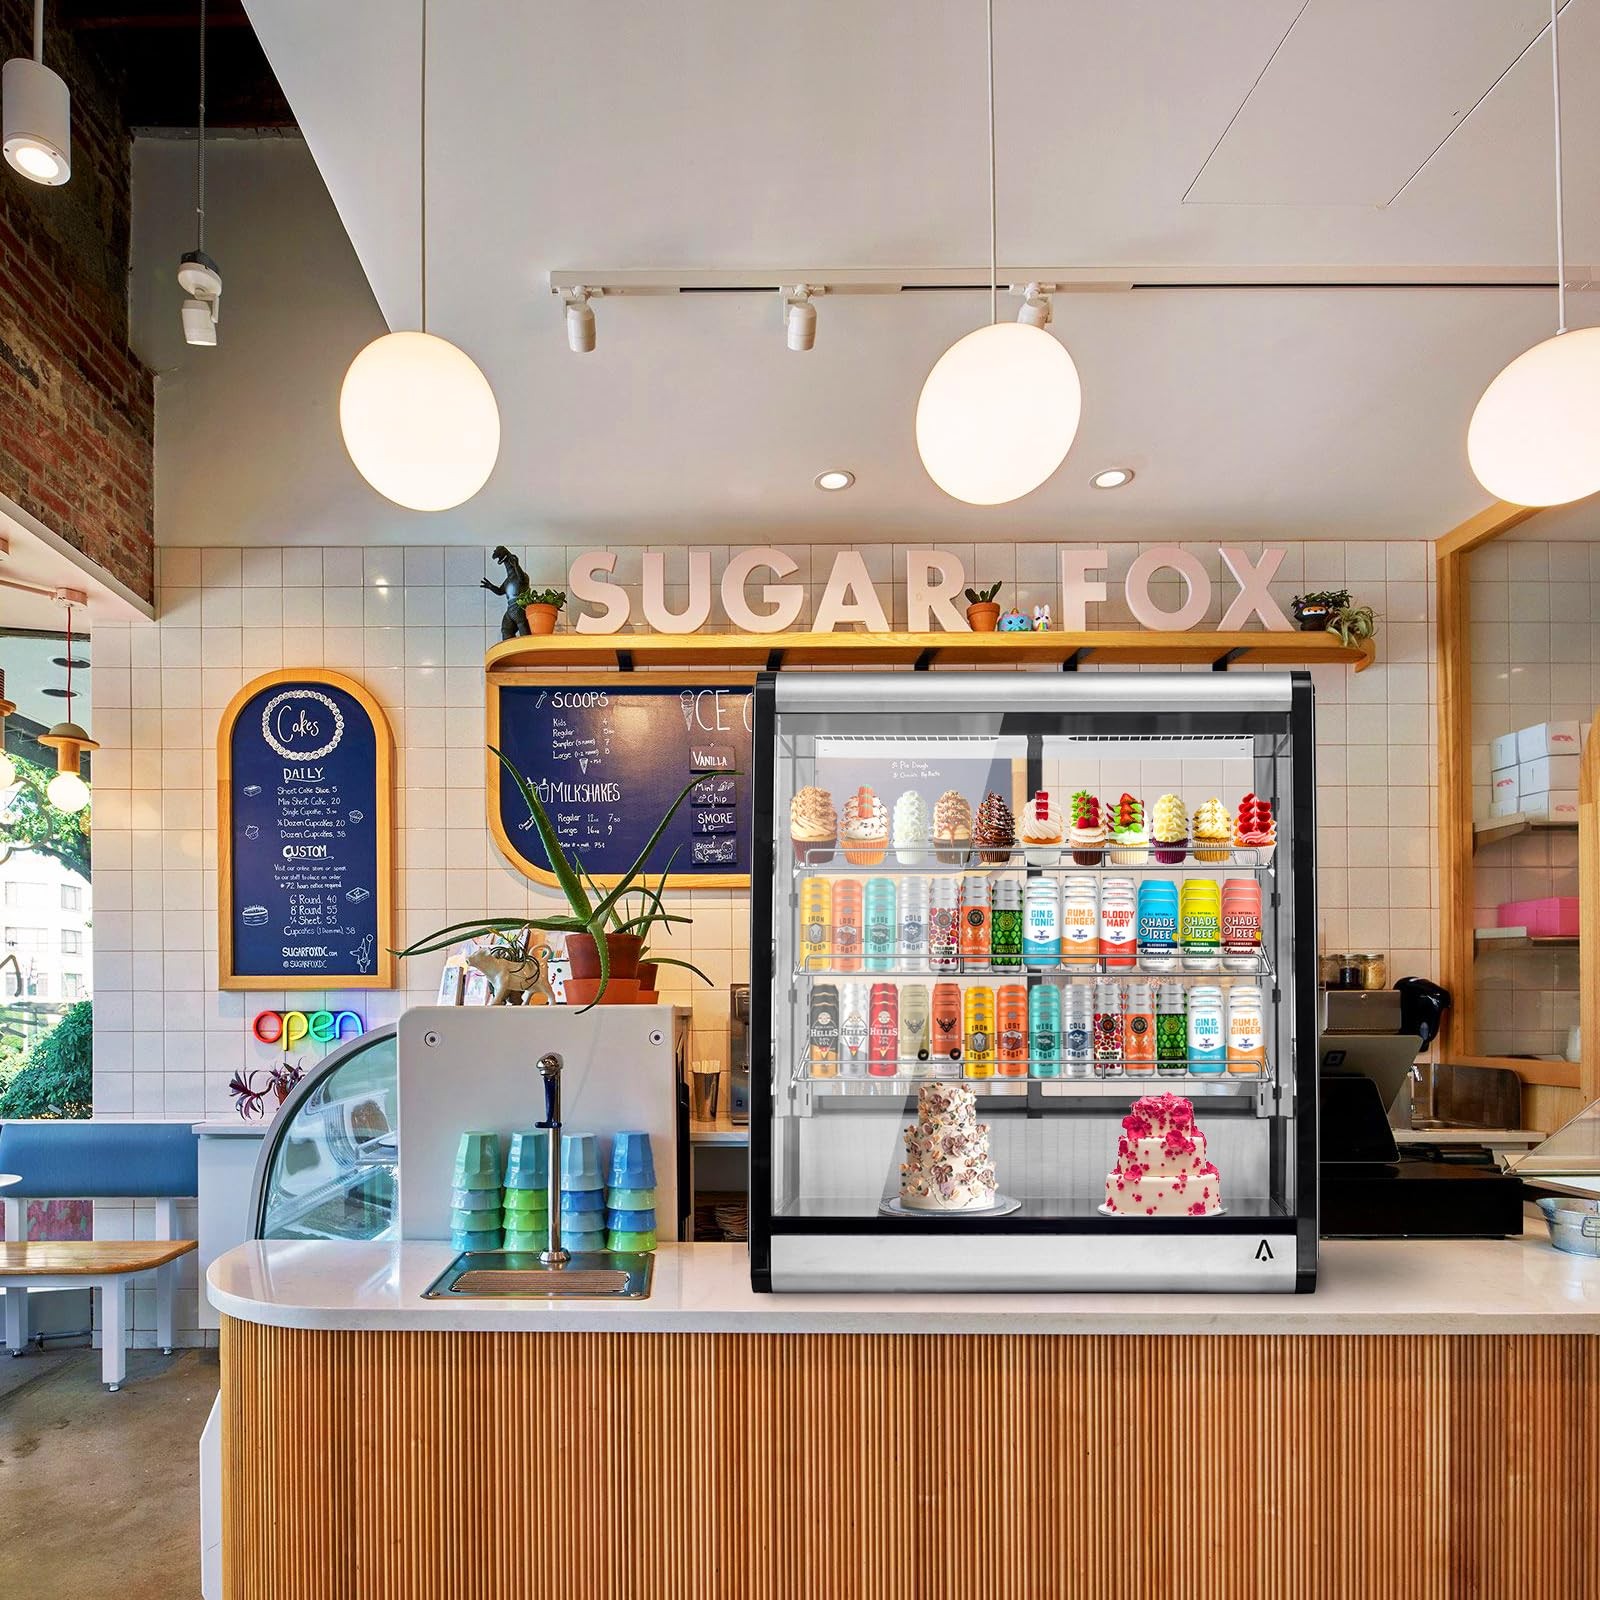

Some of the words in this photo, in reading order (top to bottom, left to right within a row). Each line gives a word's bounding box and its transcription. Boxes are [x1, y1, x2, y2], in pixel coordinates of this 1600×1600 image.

[569, 547, 973, 635] SUGAR
[1062, 546, 1296, 632] FOX
[552, 691, 609, 708] SCOOPS
[277, 705, 319, 743] Cakes
[553, 718, 567, 727] Kids
[553, 728, 575, 738] Regular
[552, 740, 575, 749] Sampler
[553, 750, 572, 760] Large
[692, 751, 728, 767] VANILLA
[283, 767, 324, 780] DAILY
[550, 782, 621, 803] MILKSHAKES
[694, 783, 715, 792] Mint
[331, 797, 341, 805] 20
[707, 793, 727, 804] Chip
[283, 818, 305, 827] Dozen
[336, 819, 346, 827] 20
[557, 813, 581, 824] Regular
[697, 811, 734, 825] S'MORE
[280, 829, 304, 839] Dozen
[557, 825, 578, 836] Large
[282, 844, 327, 858] CUSTOM
[326, 894, 337, 904] 40
[326, 905, 338, 915] 55
[1031, 909, 1046, 918] GIN
[1047, 909, 1054, 918] &
[1067, 908, 1086, 917] RUM
[1086, 908, 1094, 917] &
[1102, 910, 1135, 919] BLOODY
[326, 915, 338, 924] 55
[807, 915, 825, 923] IRON
[905, 914, 922, 922] COLD
[1029, 918, 1055, 927] TONIC
[1064, 917, 1096, 926] GINGER
[1106, 919, 1130, 927] MARY
[1139, 917, 1176, 937] SHADE
[1182, 916, 1218, 936] SHADE
[1223, 916, 1259, 935] SHADE
[283, 925, 315, 937] Cupcakes
[1148, 927, 1176, 940] TREE
[1191, 926, 1217, 938] TREE
[1232, 926, 1259, 938] TREE
[902, 943, 924, 951] SMOKE
[1069, 1022, 1086, 1030] COLD
[1195, 1018, 1210, 1026] GIN
[1211, 1018, 1217, 1026] &
[1232, 1018, 1251, 1026] RUM
[1252, 1018, 1259, 1026] &
[253, 1010, 364, 1052] open
[1194, 1026, 1219, 1035] TONIC
[1231, 1026, 1261, 1035] GINGER
[1067, 1050, 1089, 1058] SMOKE
